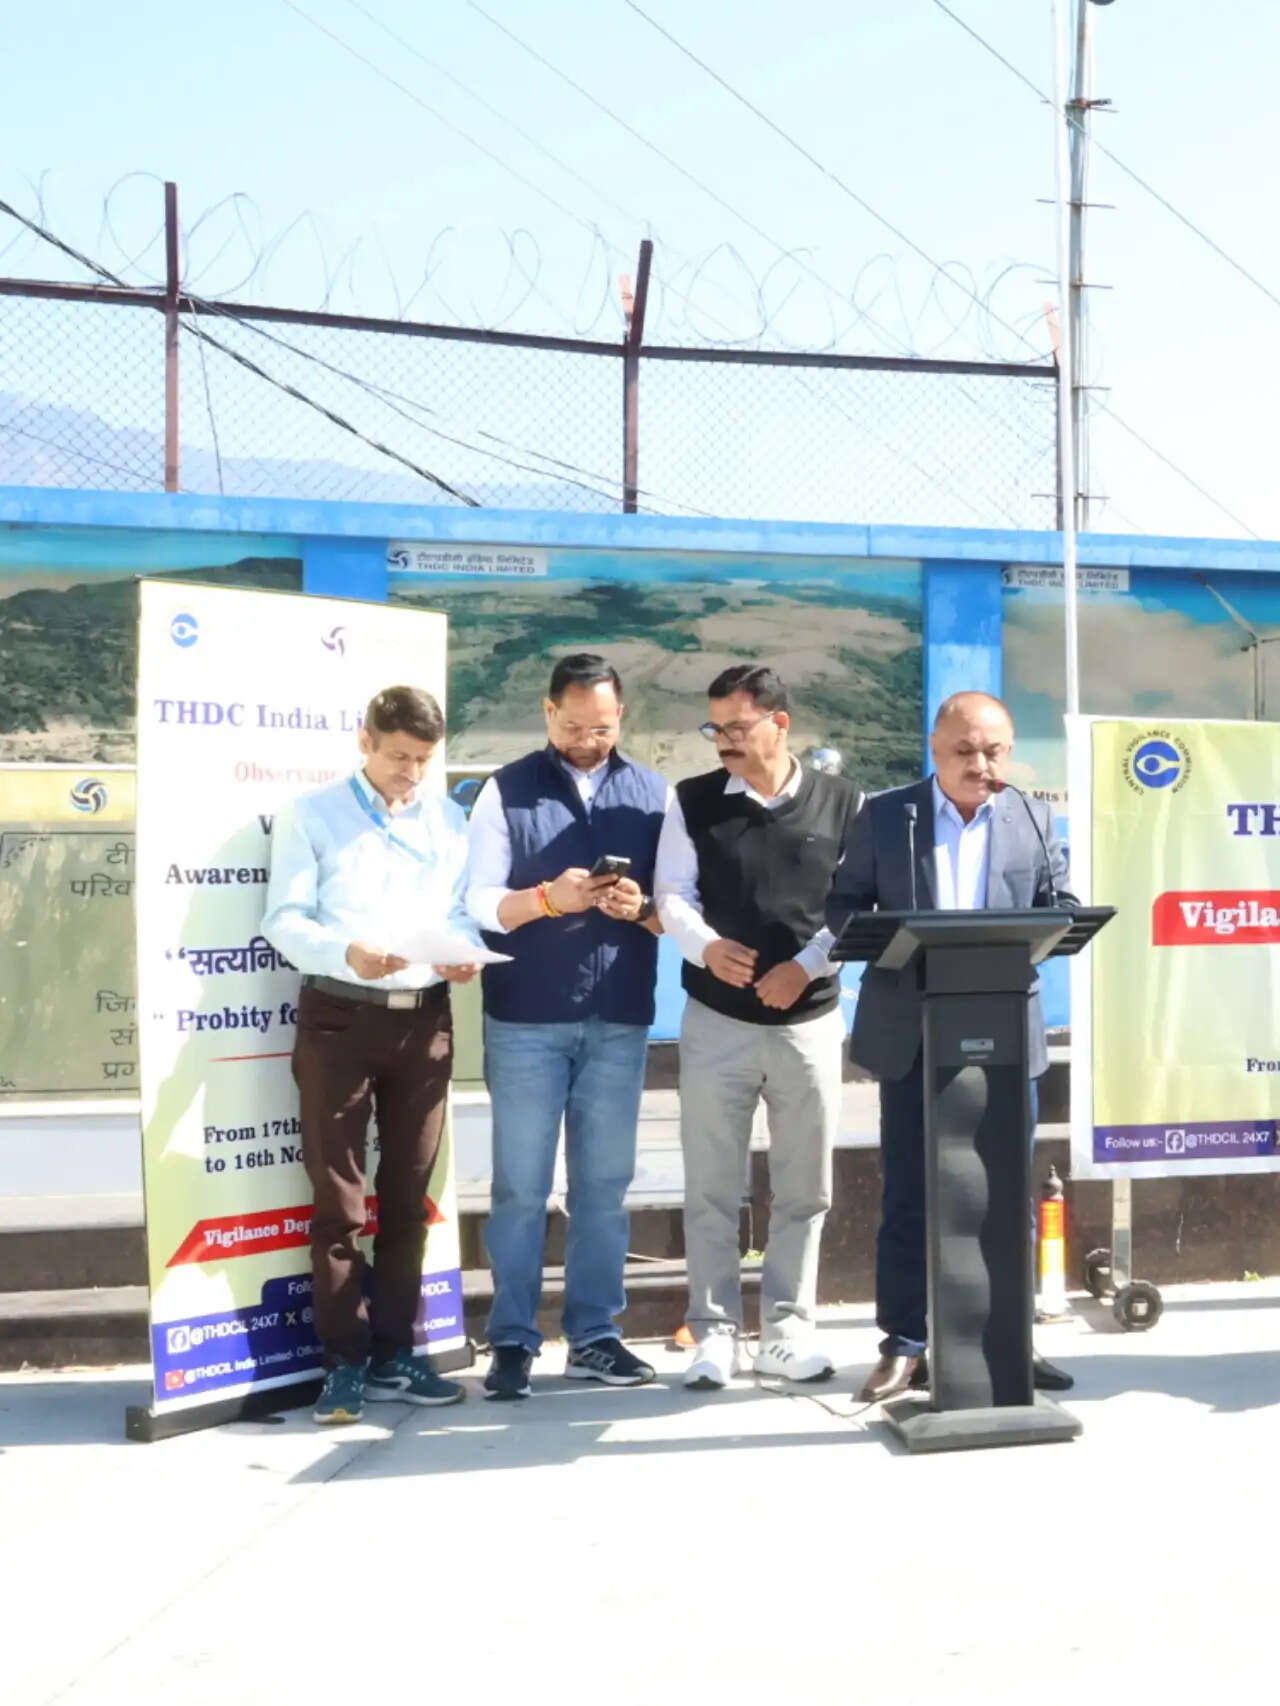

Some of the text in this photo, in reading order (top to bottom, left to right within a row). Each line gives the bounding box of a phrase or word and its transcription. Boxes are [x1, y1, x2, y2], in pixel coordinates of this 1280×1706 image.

[154, 699, 245, 727] THDC
[257, 704, 330, 731] India
[165, 863, 268, 885] Awaren
[176, 1002, 272, 1033] Probity
[279, 1002, 298, 1025] fo
[204, 1118, 301, 1144] From 17th
[1105, 1136, 1140, 1149] Follow
[1186, 1133, 1239, 1148] @THDCIL
[1243, 1131, 1270, 1144] 24X7
[205, 1156, 226, 1173] to
[234, 1149, 275, 1170] 16th
[204, 1223, 279, 1248] Vigilance
[287, 1281, 312, 1295] Foll
[251, 1313, 279, 1331] 24X7
